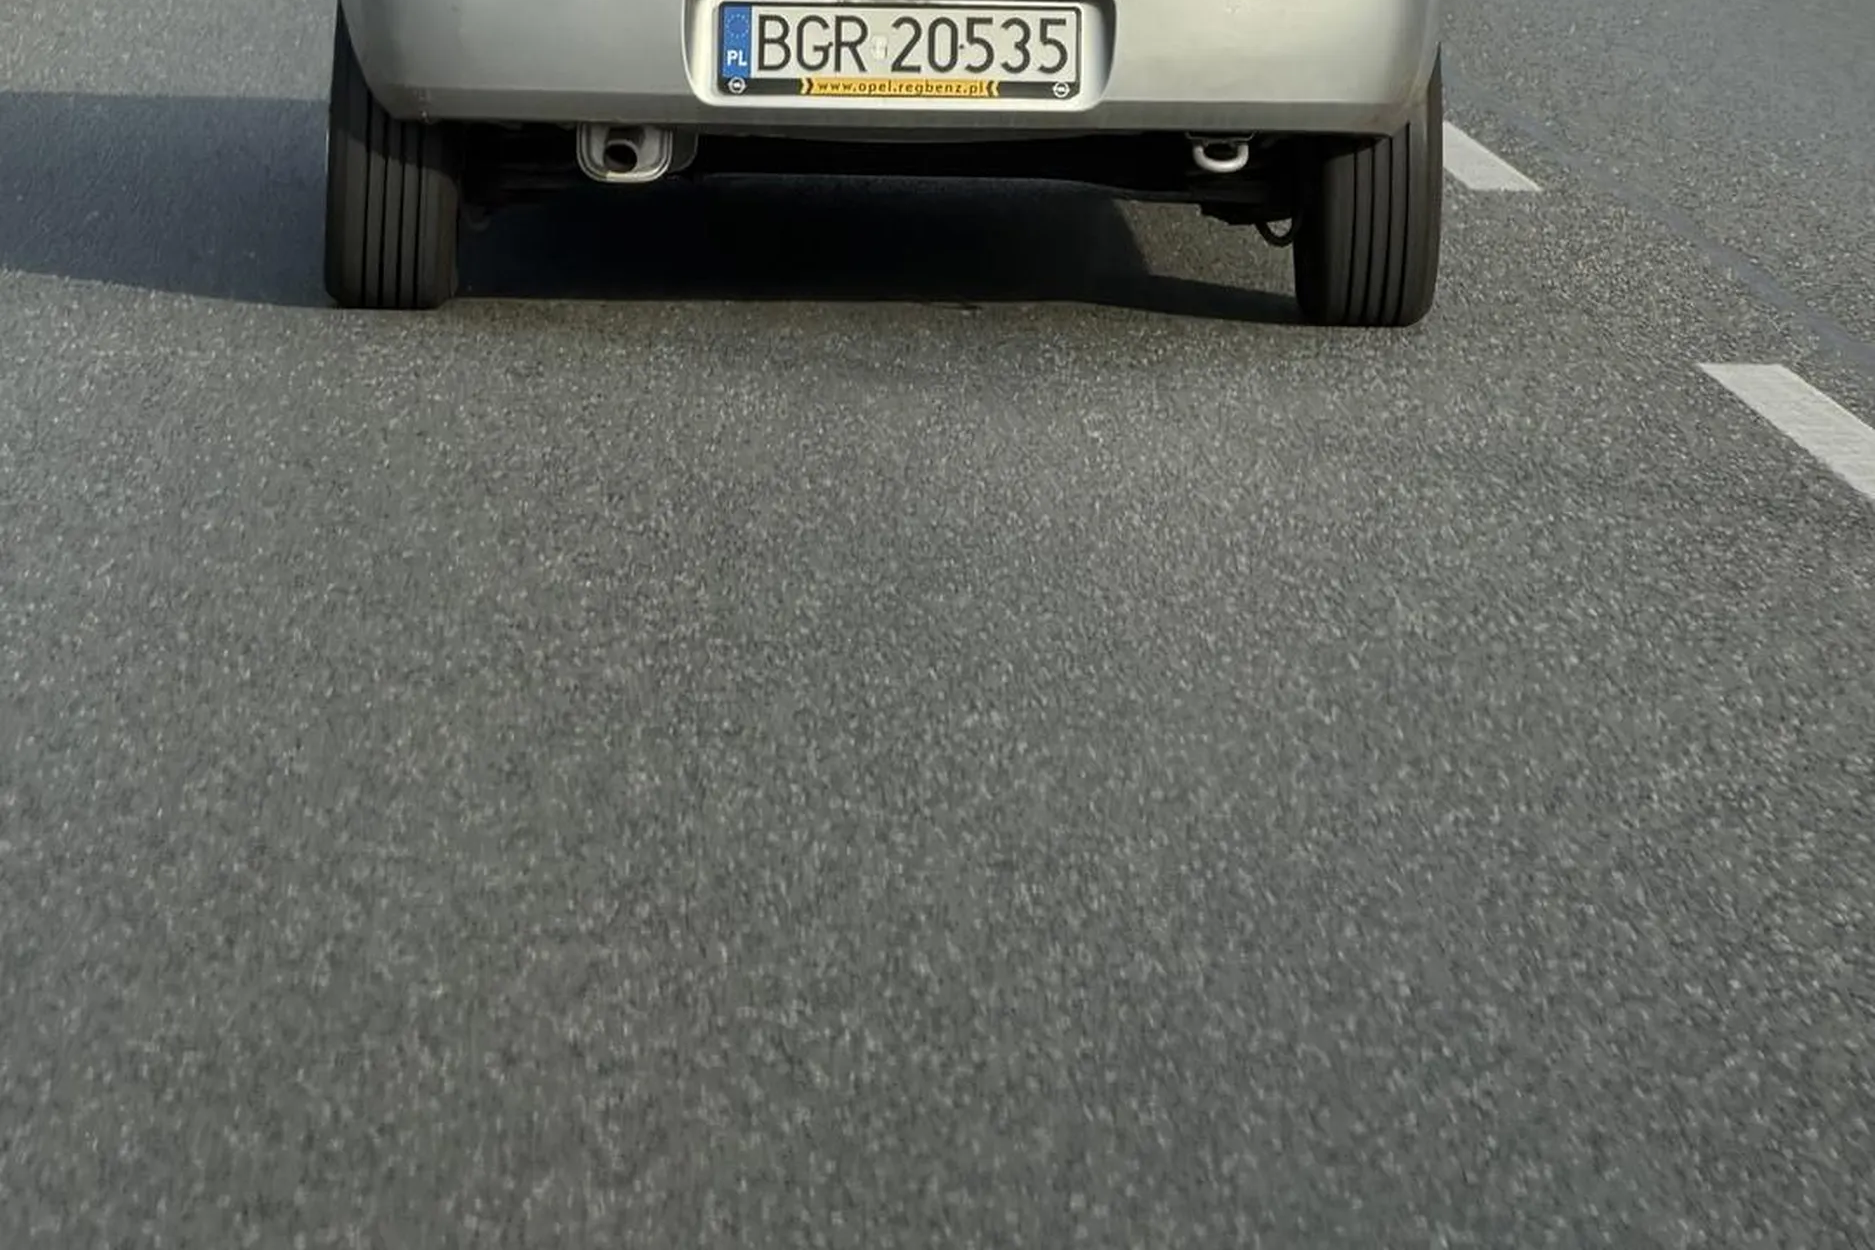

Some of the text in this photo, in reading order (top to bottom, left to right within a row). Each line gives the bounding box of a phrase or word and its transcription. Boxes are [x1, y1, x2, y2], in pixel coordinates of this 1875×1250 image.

[758, 14, 1068, 74] BGR 20535
[727, 49, 748, 66] PL
[817, 80, 983, 96] www.opel.regbenz.pl
